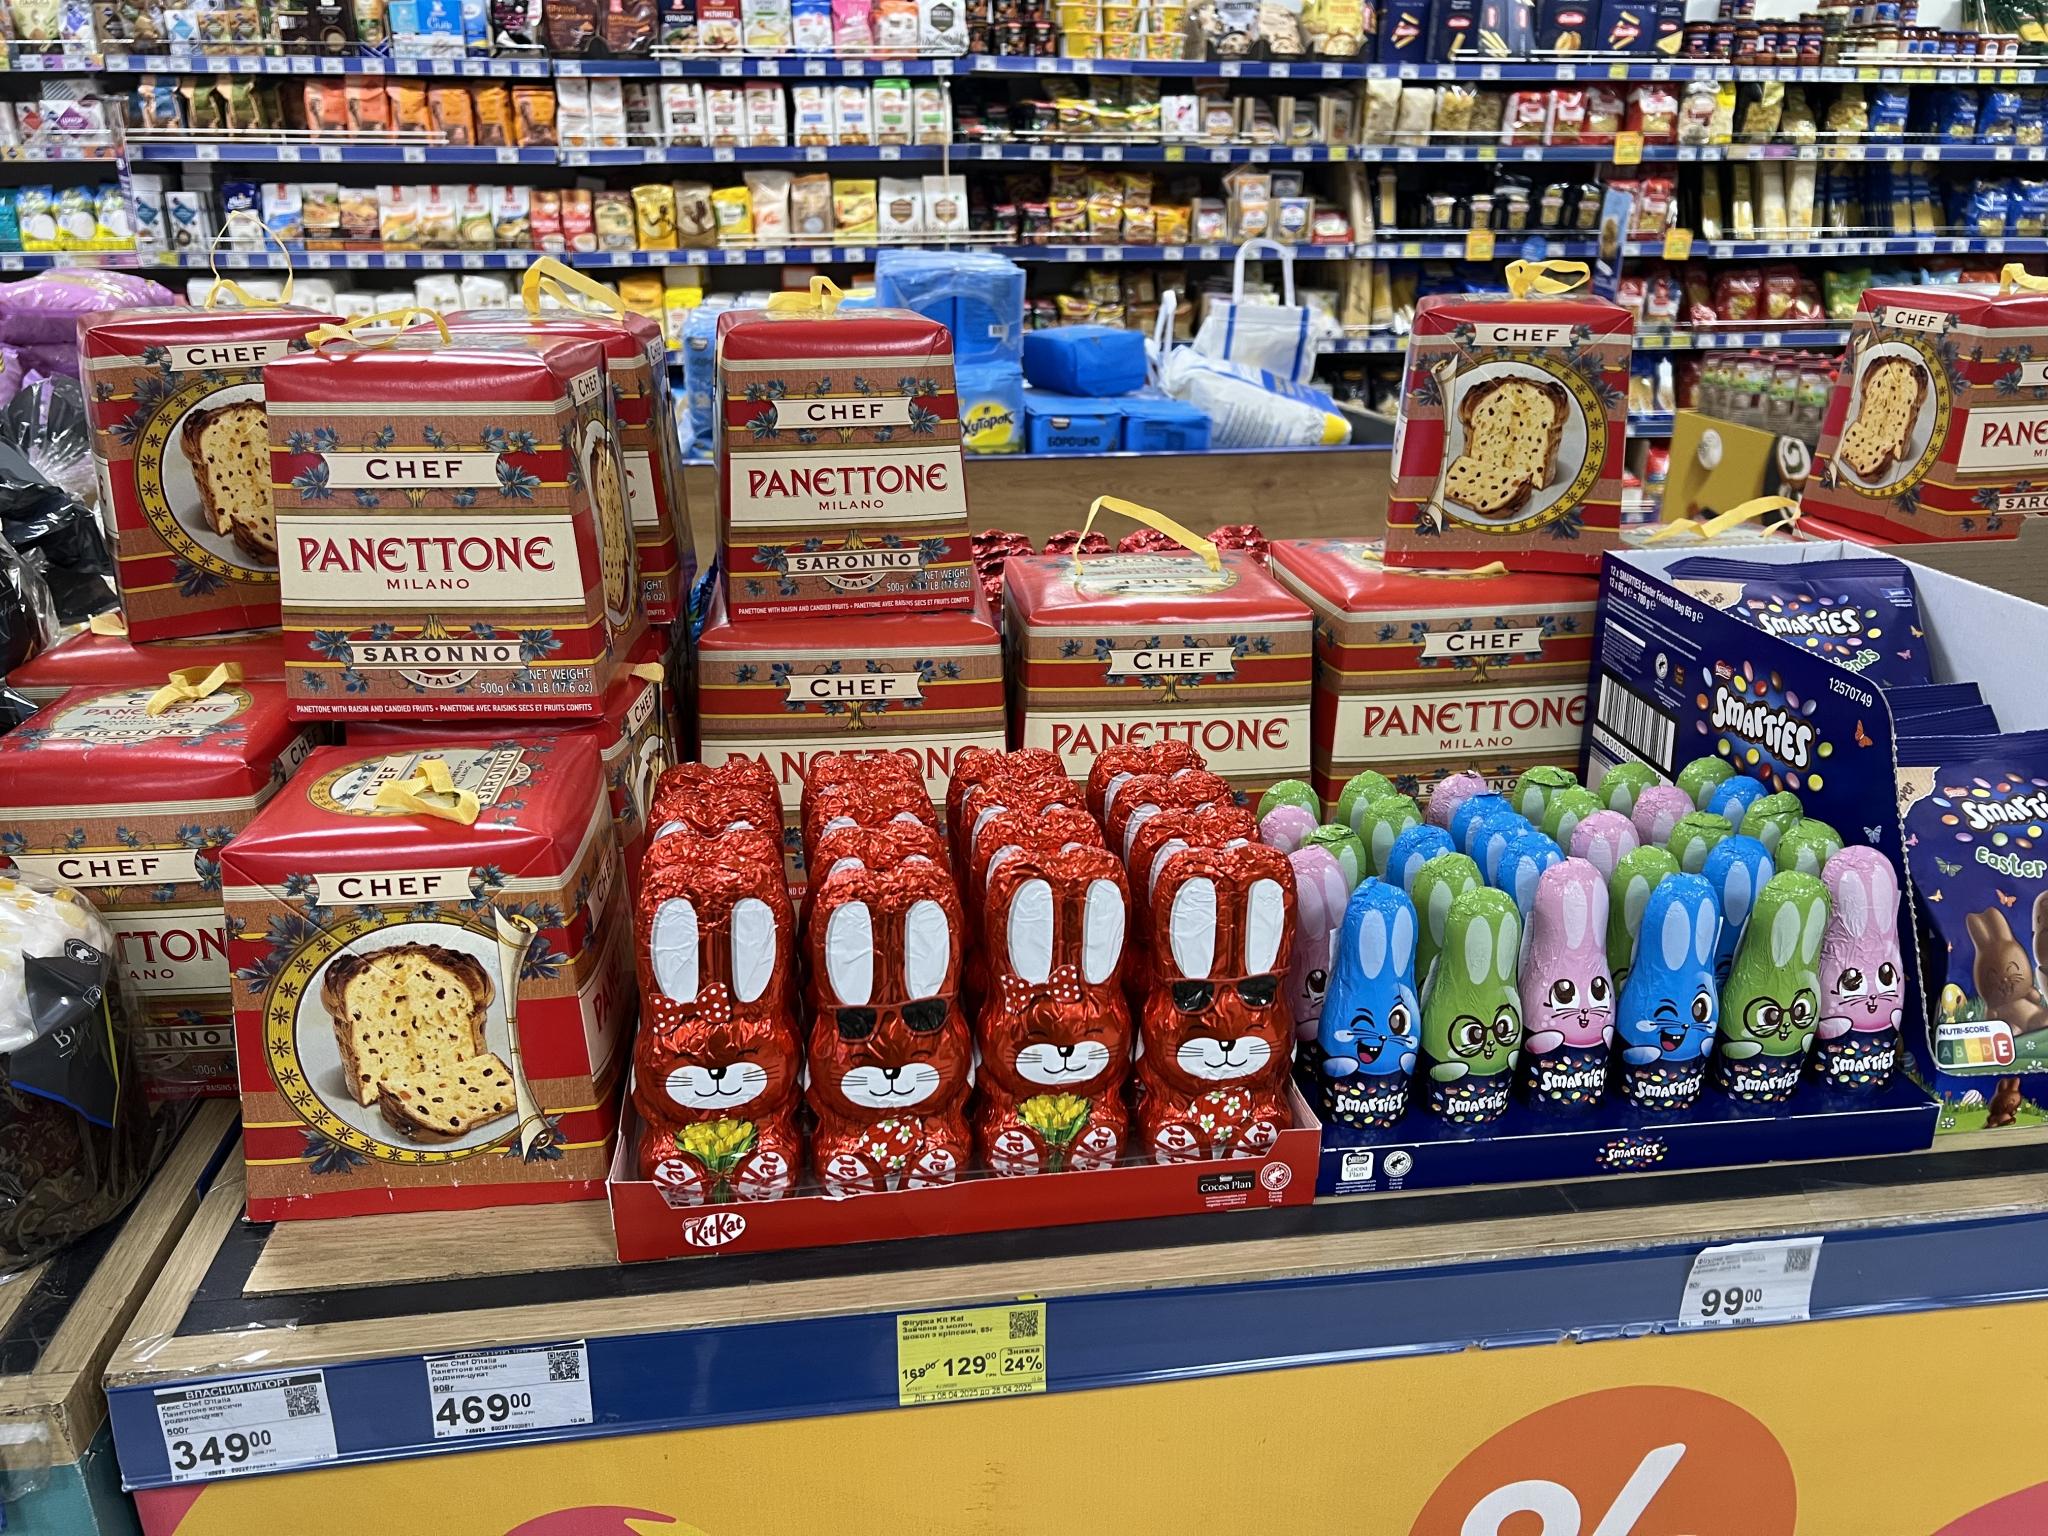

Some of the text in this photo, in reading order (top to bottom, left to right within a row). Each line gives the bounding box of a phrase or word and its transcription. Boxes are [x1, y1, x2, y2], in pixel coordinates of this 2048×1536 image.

[1895, 312, 1938, 328] CHEF
[1493, 328, 1560, 342] CHEF
[187, 347, 267, 365] CHEF
[578, 374, 598, 398] CHEF
[807, 403, 884, 421] CHEF
[366, 458, 463, 480] CHEF
[748, 463, 948, 498] PANETTONE
[819, 499, 884, 511] MILANO
[297, 536, 555, 573] PANETTONE
[797, 553, 911, 570] SARONNO
[837, 575, 874, 588] ITALY
[924, 570, 939, 580] NET
[386, 578, 470, 590] MILANO
[886, 582, 904, 593] 500g
[1641, 582, 1657, 598] Easter
[1674, 599, 1685, 616] Bag
[1684, 604, 1692, 618] 65
[1447, 633, 1524, 651] CHEF
[363, 646, 511, 662] SARONNO
[1133, 652, 1214, 669] CHEF
[416, 672, 464, 686] ITALY
[529, 670, 548, 680] NET
[480, 682, 504, 696] 500g
[538, 682, 549, 693] LB
[578, 682, 593, 694] oz)
[810, 679, 896, 697] CHEF
[1829, 677, 1873, 708] 12570749
[297, 704, 332, 713] PANETTONE
[332, 705, 348, 713] WITH
[348, 705, 369, 713] RAISIN
[384, 704, 411, 712] CANDIED
[412, 704, 434, 712] FRUITS
[440, 704, 475, 712] PANETTONE
[475, 704, 492, 712] AVEC
[492, 704, 518, 712] RAISINS
[518, 704, 535, 712] SECS
[544, 704, 566, 712] FRUITS
[566, 703, 593, 711] CONFITS
[1364, 695, 1588, 737] PANETTONE
[1440, 736, 1513, 750] MILANO
[477, 753, 515, 800] SARONNO
[57, 858, 159, 879] CHEF
[338, 876, 442, 898] CHEF
[1939, 1026, 1990, 1036] NUTRI-SCORE
[1997, 1040, 2010, 1057] E
[1201, 1181, 1252, 1192] Cocoa Plan
[691, 1214, 742, 1245] KitKat
[1701, 1287, 1763, 1316] 99 00
[1007, 1347, 1041, 1357] Знижка
[430, 1360, 449, 1369] Кекс
[431, 1366, 474, 1376] Панеттоне
[943, 1355, 987, 1378] 129
[1004, 1356, 1043, 1373] 24%
[247, 1377, 292, 1392] ІМПОРТ
[161, 1403, 180, 1413] Кекс
[436, 1392, 532, 1427] 469 00
[167, 1426, 190, 1436] 500г
[172, 1429, 272, 1471] 349 00
